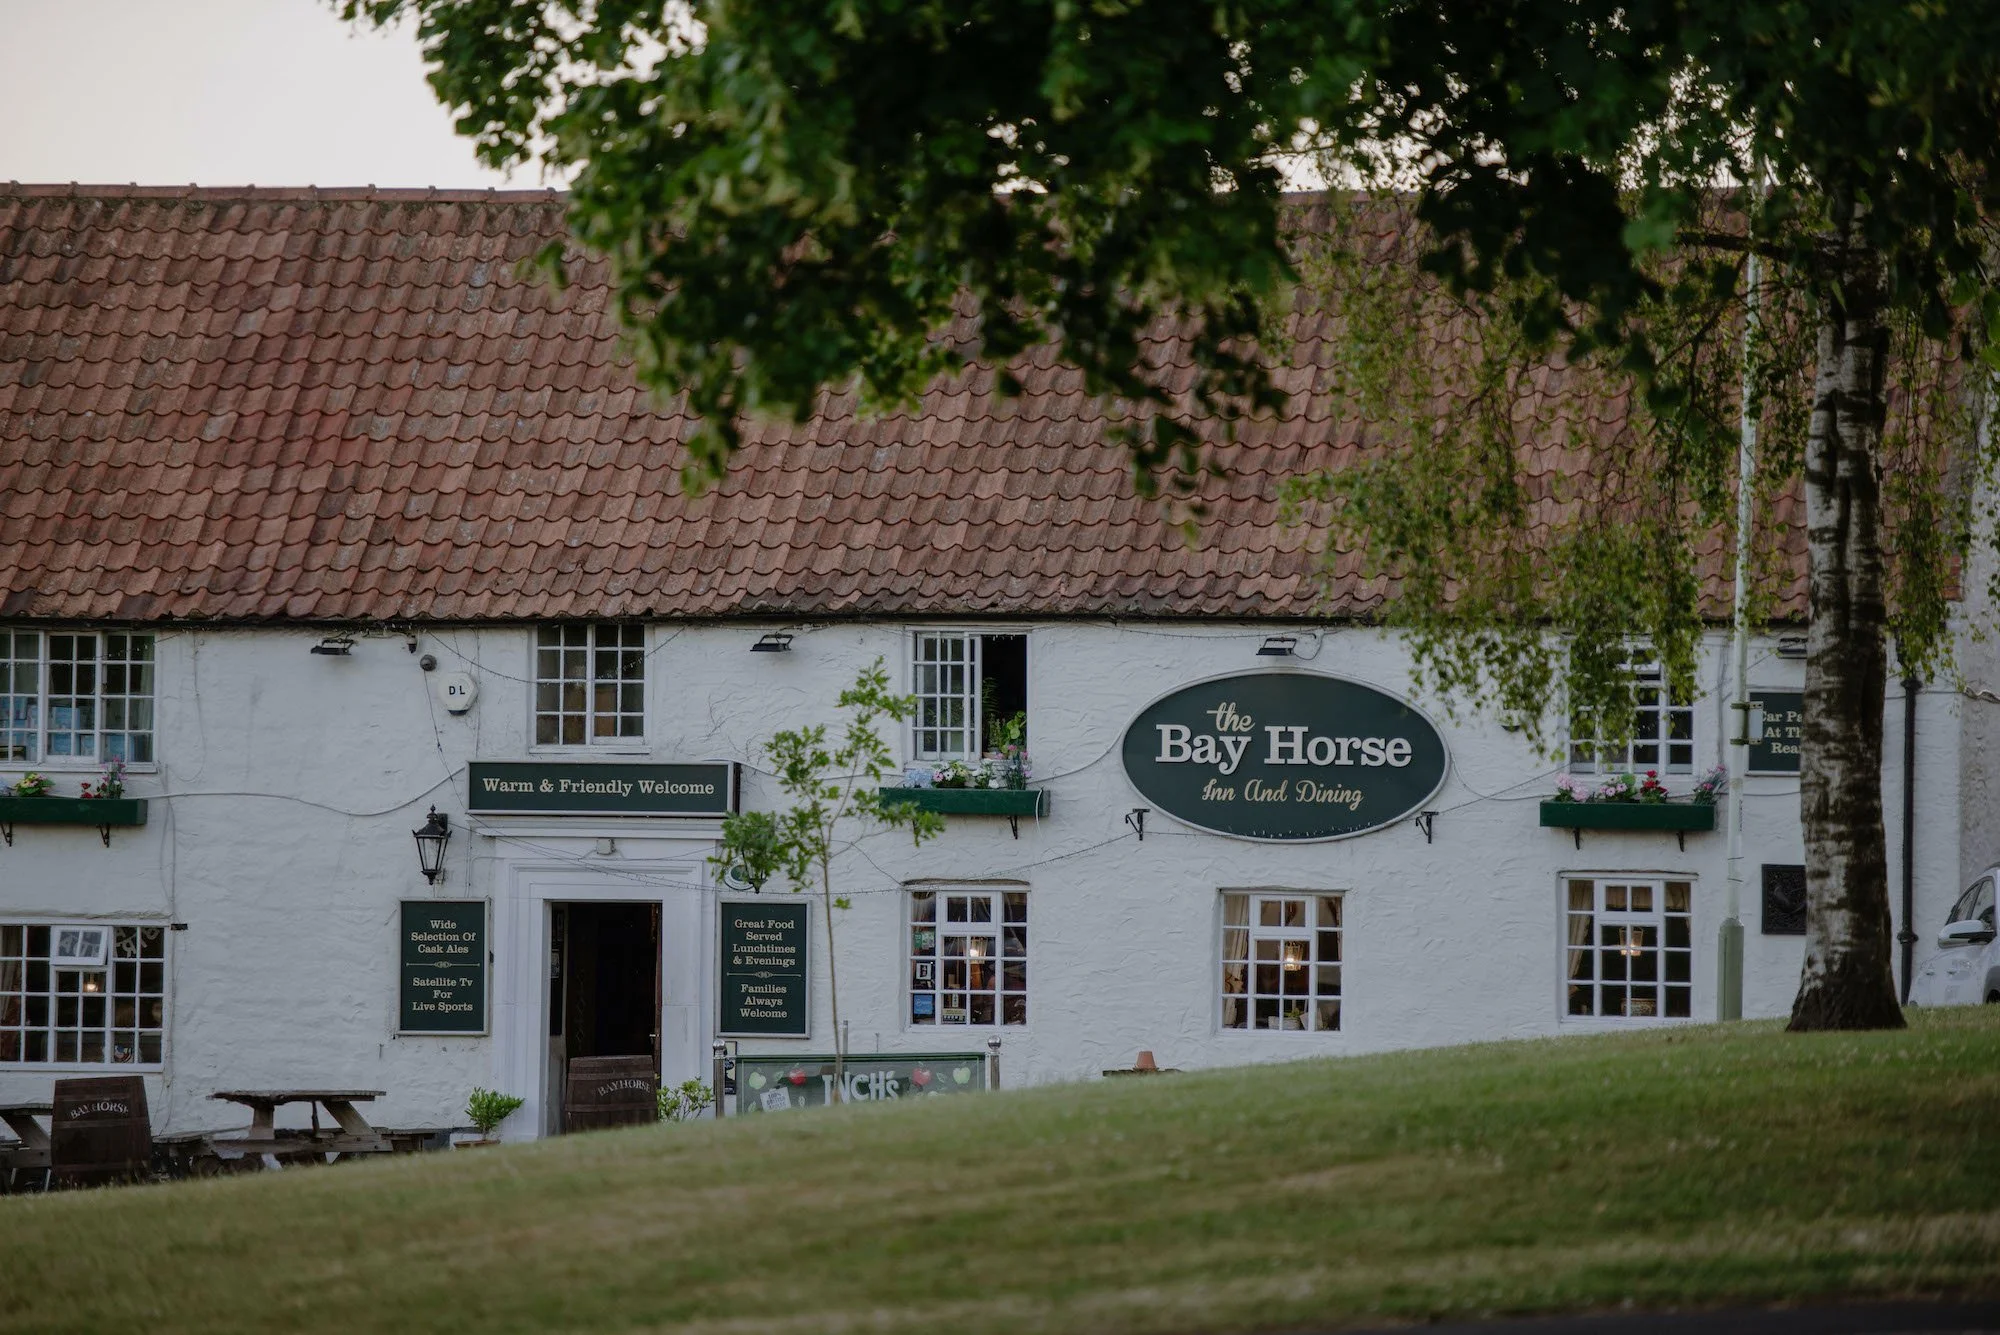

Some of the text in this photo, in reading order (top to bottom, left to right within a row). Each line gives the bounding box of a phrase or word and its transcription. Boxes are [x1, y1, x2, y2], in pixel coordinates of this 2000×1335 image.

[1207, 702, 1255, 732] the
[1764, 726, 1781, 738] At
[1155, 724, 1413, 775] Bay Horse
[1771, 742, 1801, 754] Rea
[483, 778, 715, 797] Warm & Friendly Welcome
[1202, 778, 1364, 811] Inn And Dining
[430, 920, 457, 930] Wide
[734, 919, 795, 930] Great Food
[411, 931, 477, 942] Selection Of
[745, 931, 783, 941] Served
[417, 943, 469, 954] Cask Ales
[732, 943, 796, 954] Lunchtimes
[732, 955, 796, 968] & Evenings
[412, 977, 474, 987] Satellite Tv
[433, 989, 453, 999] For
[740, 984, 787, 994] Families
[412, 1001, 474, 1013] Live Sports
[744, 996, 783, 1008] Always
[740, 1008, 788, 1019] Welcome
